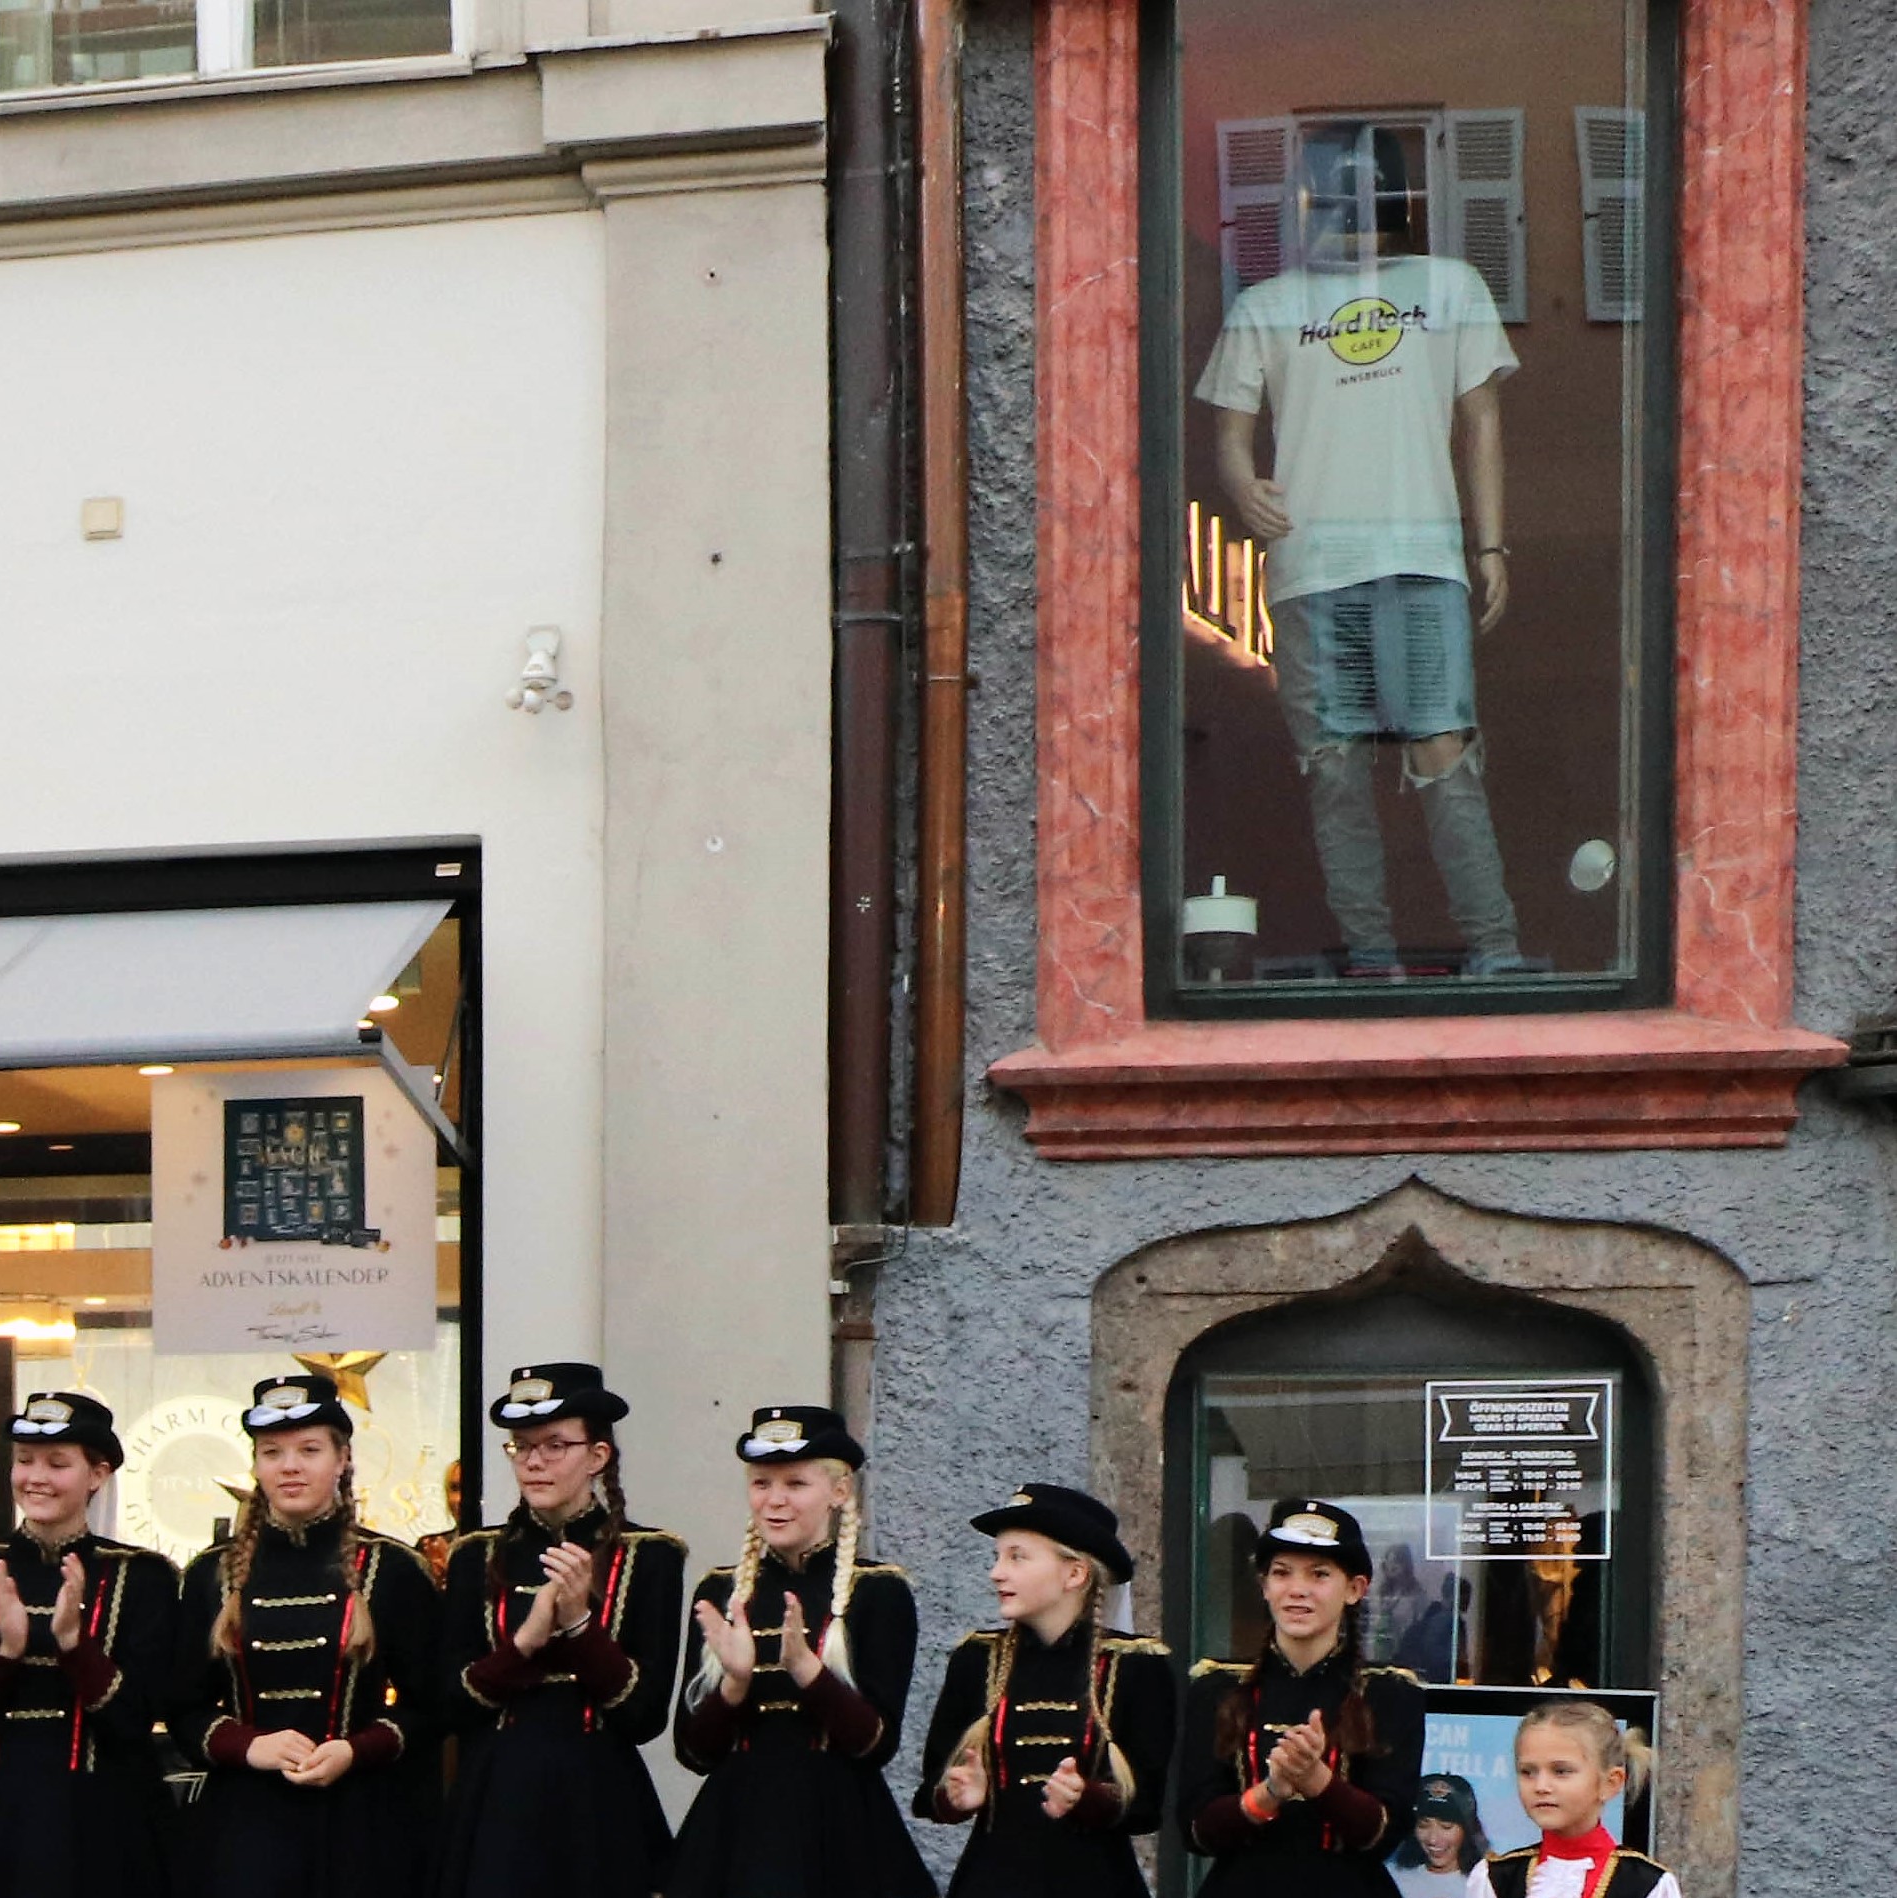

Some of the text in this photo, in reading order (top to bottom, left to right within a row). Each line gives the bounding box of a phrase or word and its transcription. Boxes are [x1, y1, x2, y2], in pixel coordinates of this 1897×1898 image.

[1299, 305, 1429, 346] Hard Rock
[1350, 338, 1382, 353] CAFE
[1335, 366, 1403, 387] INNSBRUCK
[201, 1267, 390, 1288] ADVENTSKALENDER
